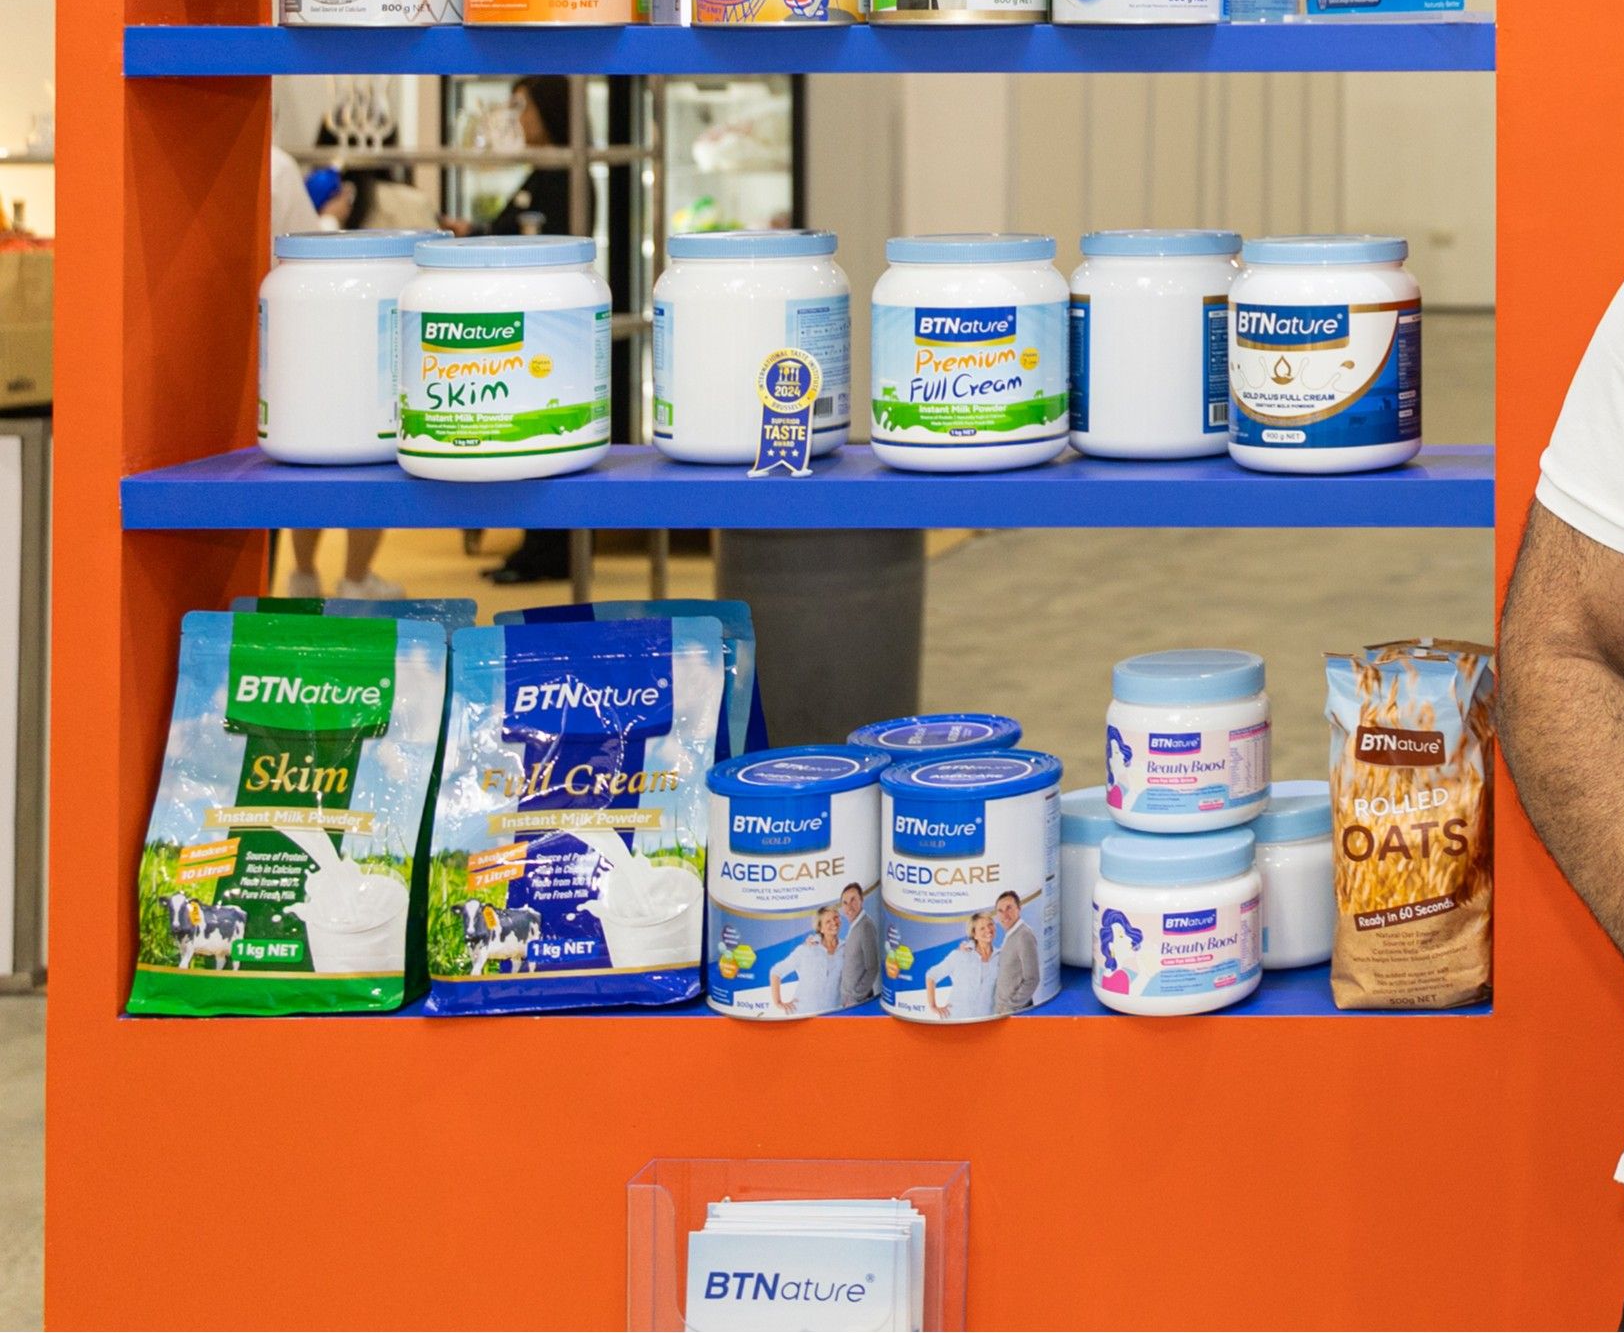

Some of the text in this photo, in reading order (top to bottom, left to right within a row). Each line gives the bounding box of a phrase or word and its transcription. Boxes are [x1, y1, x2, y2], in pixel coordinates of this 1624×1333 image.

[422, 354, 523, 381] Premium
[916, 347, 1016, 374] Premium
[426, 381, 509, 410] Skim
[775, 385, 800, 397] 2024
[952, 372, 1022, 398] Cream
[764, 425, 806, 440] TASTE
[246, 752, 348, 794] Skim
[481, 763, 680, 798] Full Cream
[1354, 787, 1449, 818] ROLLED
[1342, 818, 1469, 862] OATS
[245, 851, 308, 862] Source of Protein
[720, 856, 845, 883] AGEDCARE
[887, 861, 1000, 886] AGEDCARE
[533, 890, 590, 900] Pure Fresh Milk
[1358, 897, 1454, 928] Ready in 60 Seconds
[236, 943, 298, 959] 1 kg NET
[533, 941, 595, 959] 1 kg NET
